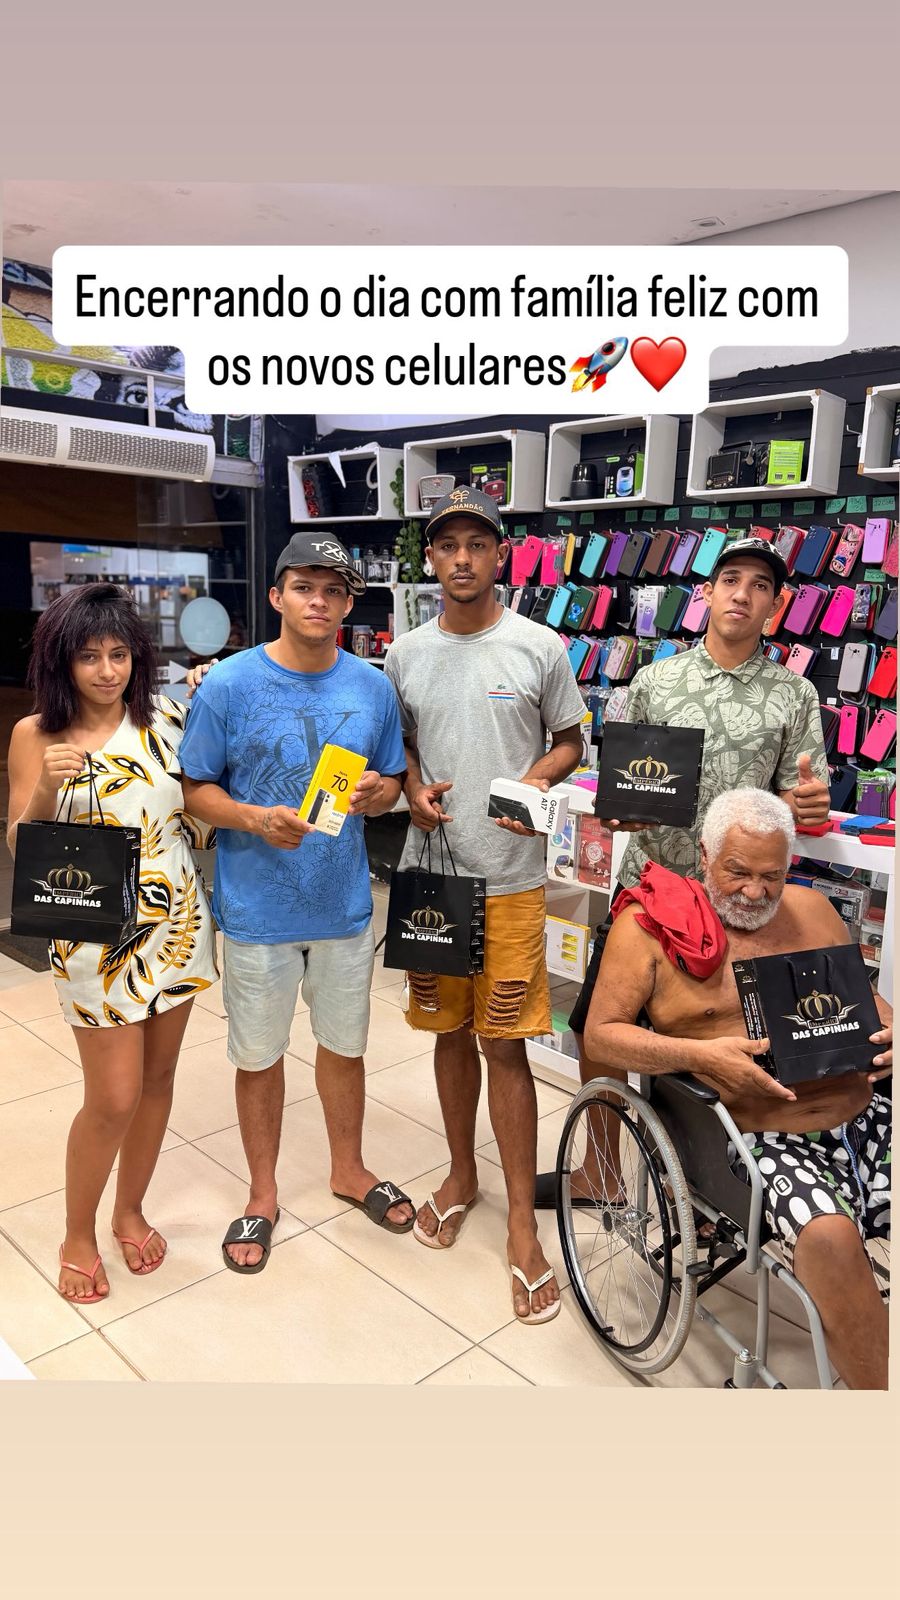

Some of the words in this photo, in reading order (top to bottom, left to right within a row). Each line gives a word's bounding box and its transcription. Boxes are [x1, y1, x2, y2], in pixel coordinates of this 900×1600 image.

[331, 774, 348, 792] 70
[616, 782, 633, 790] DAS
[635, 784, 677, 795] CAPINHAS
[540, 797, 548, 812] A17
[545, 799, 558, 831] Galaxy
[33, 894, 52, 904] DAS
[55, 897, 102, 908] CAPINHAS
[401, 932, 415, 940] DAS
[416, 934, 453, 944] CAPINHAS
[791, 1030, 811, 1041] DAS
[812, 1021, 860, 1037] CAPINHAS
